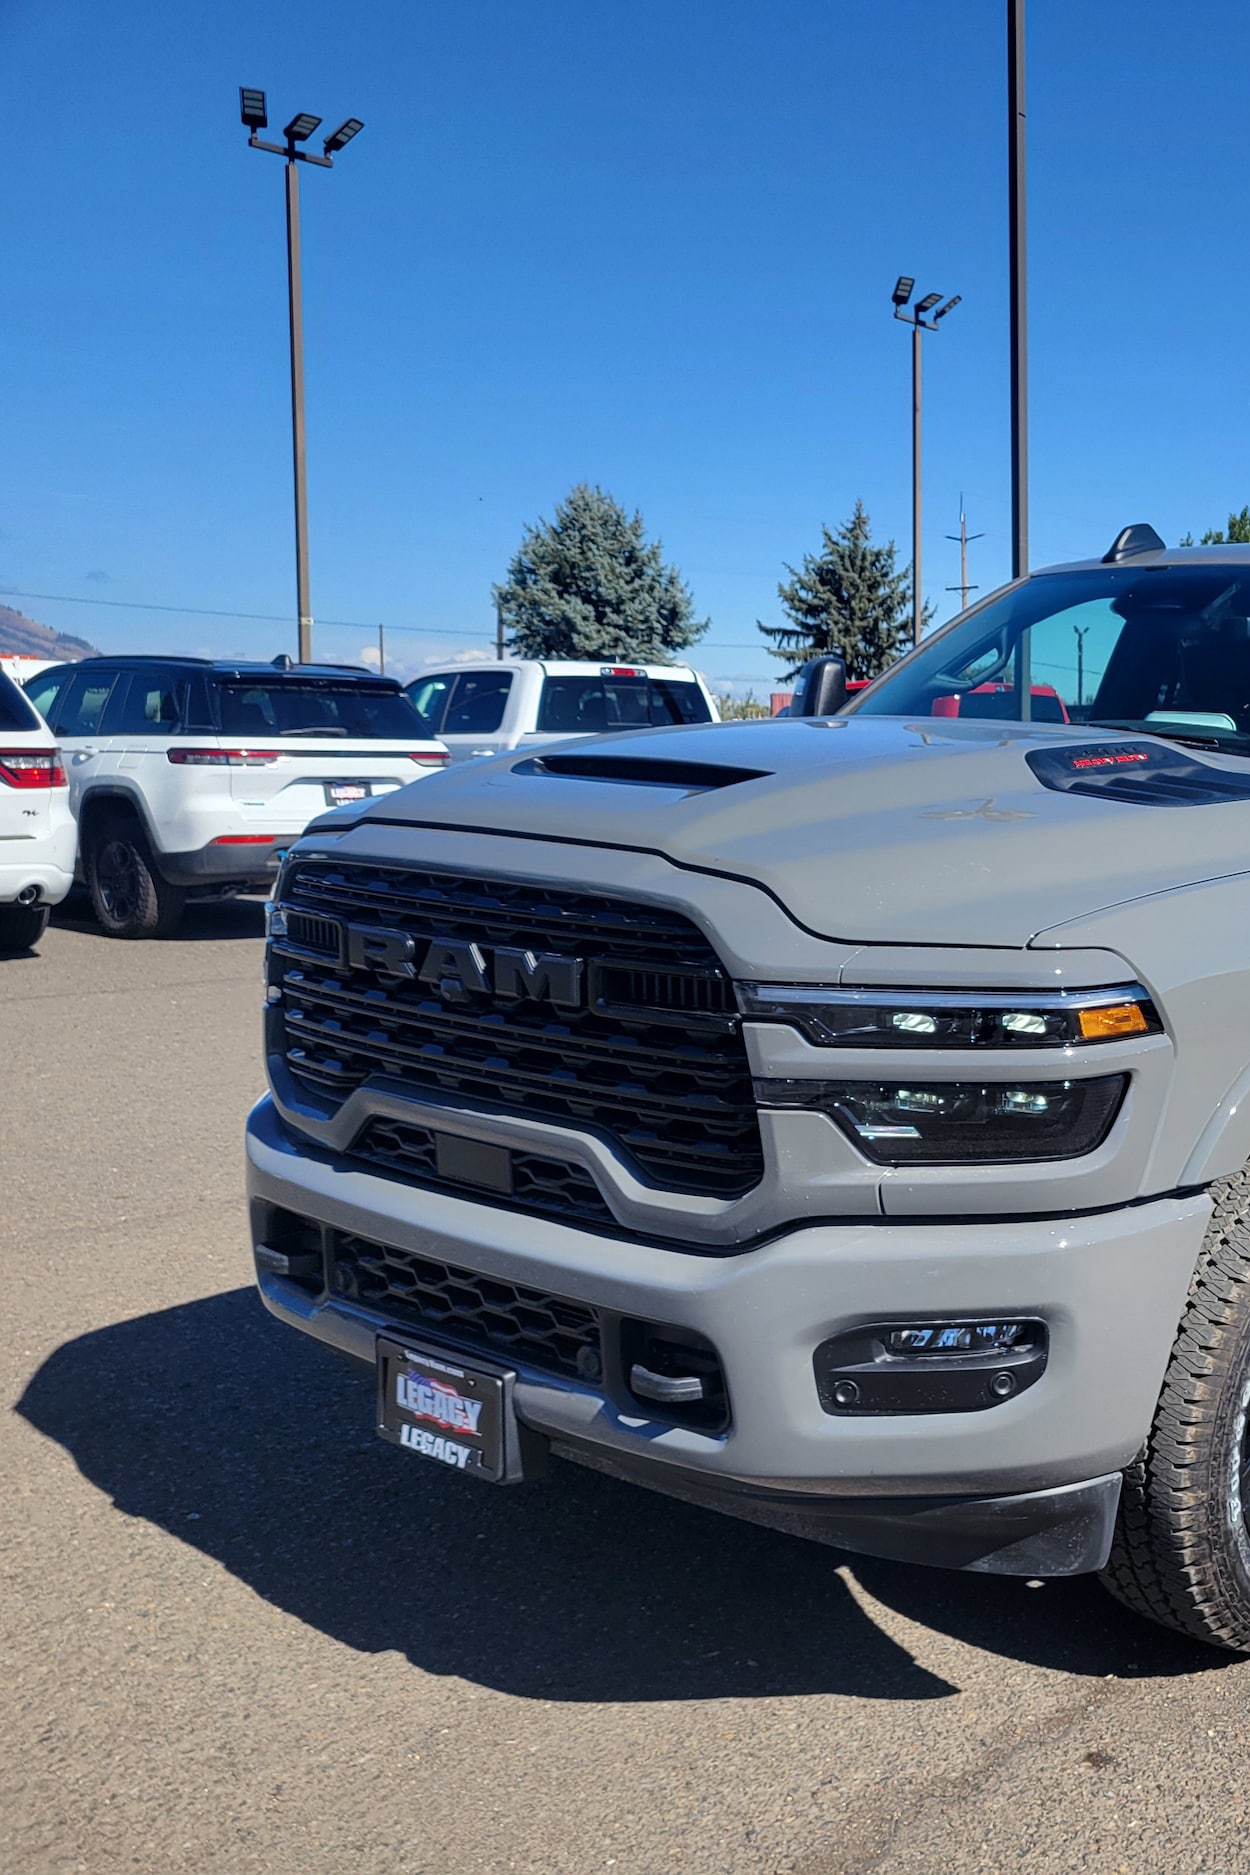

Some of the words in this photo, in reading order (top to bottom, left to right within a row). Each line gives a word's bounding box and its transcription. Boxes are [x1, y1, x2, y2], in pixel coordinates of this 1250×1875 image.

[347, 922, 584, 1007] RAM
[396, 1373, 482, 1432] LEGACY
[400, 1424, 472, 1469] LEGACY
